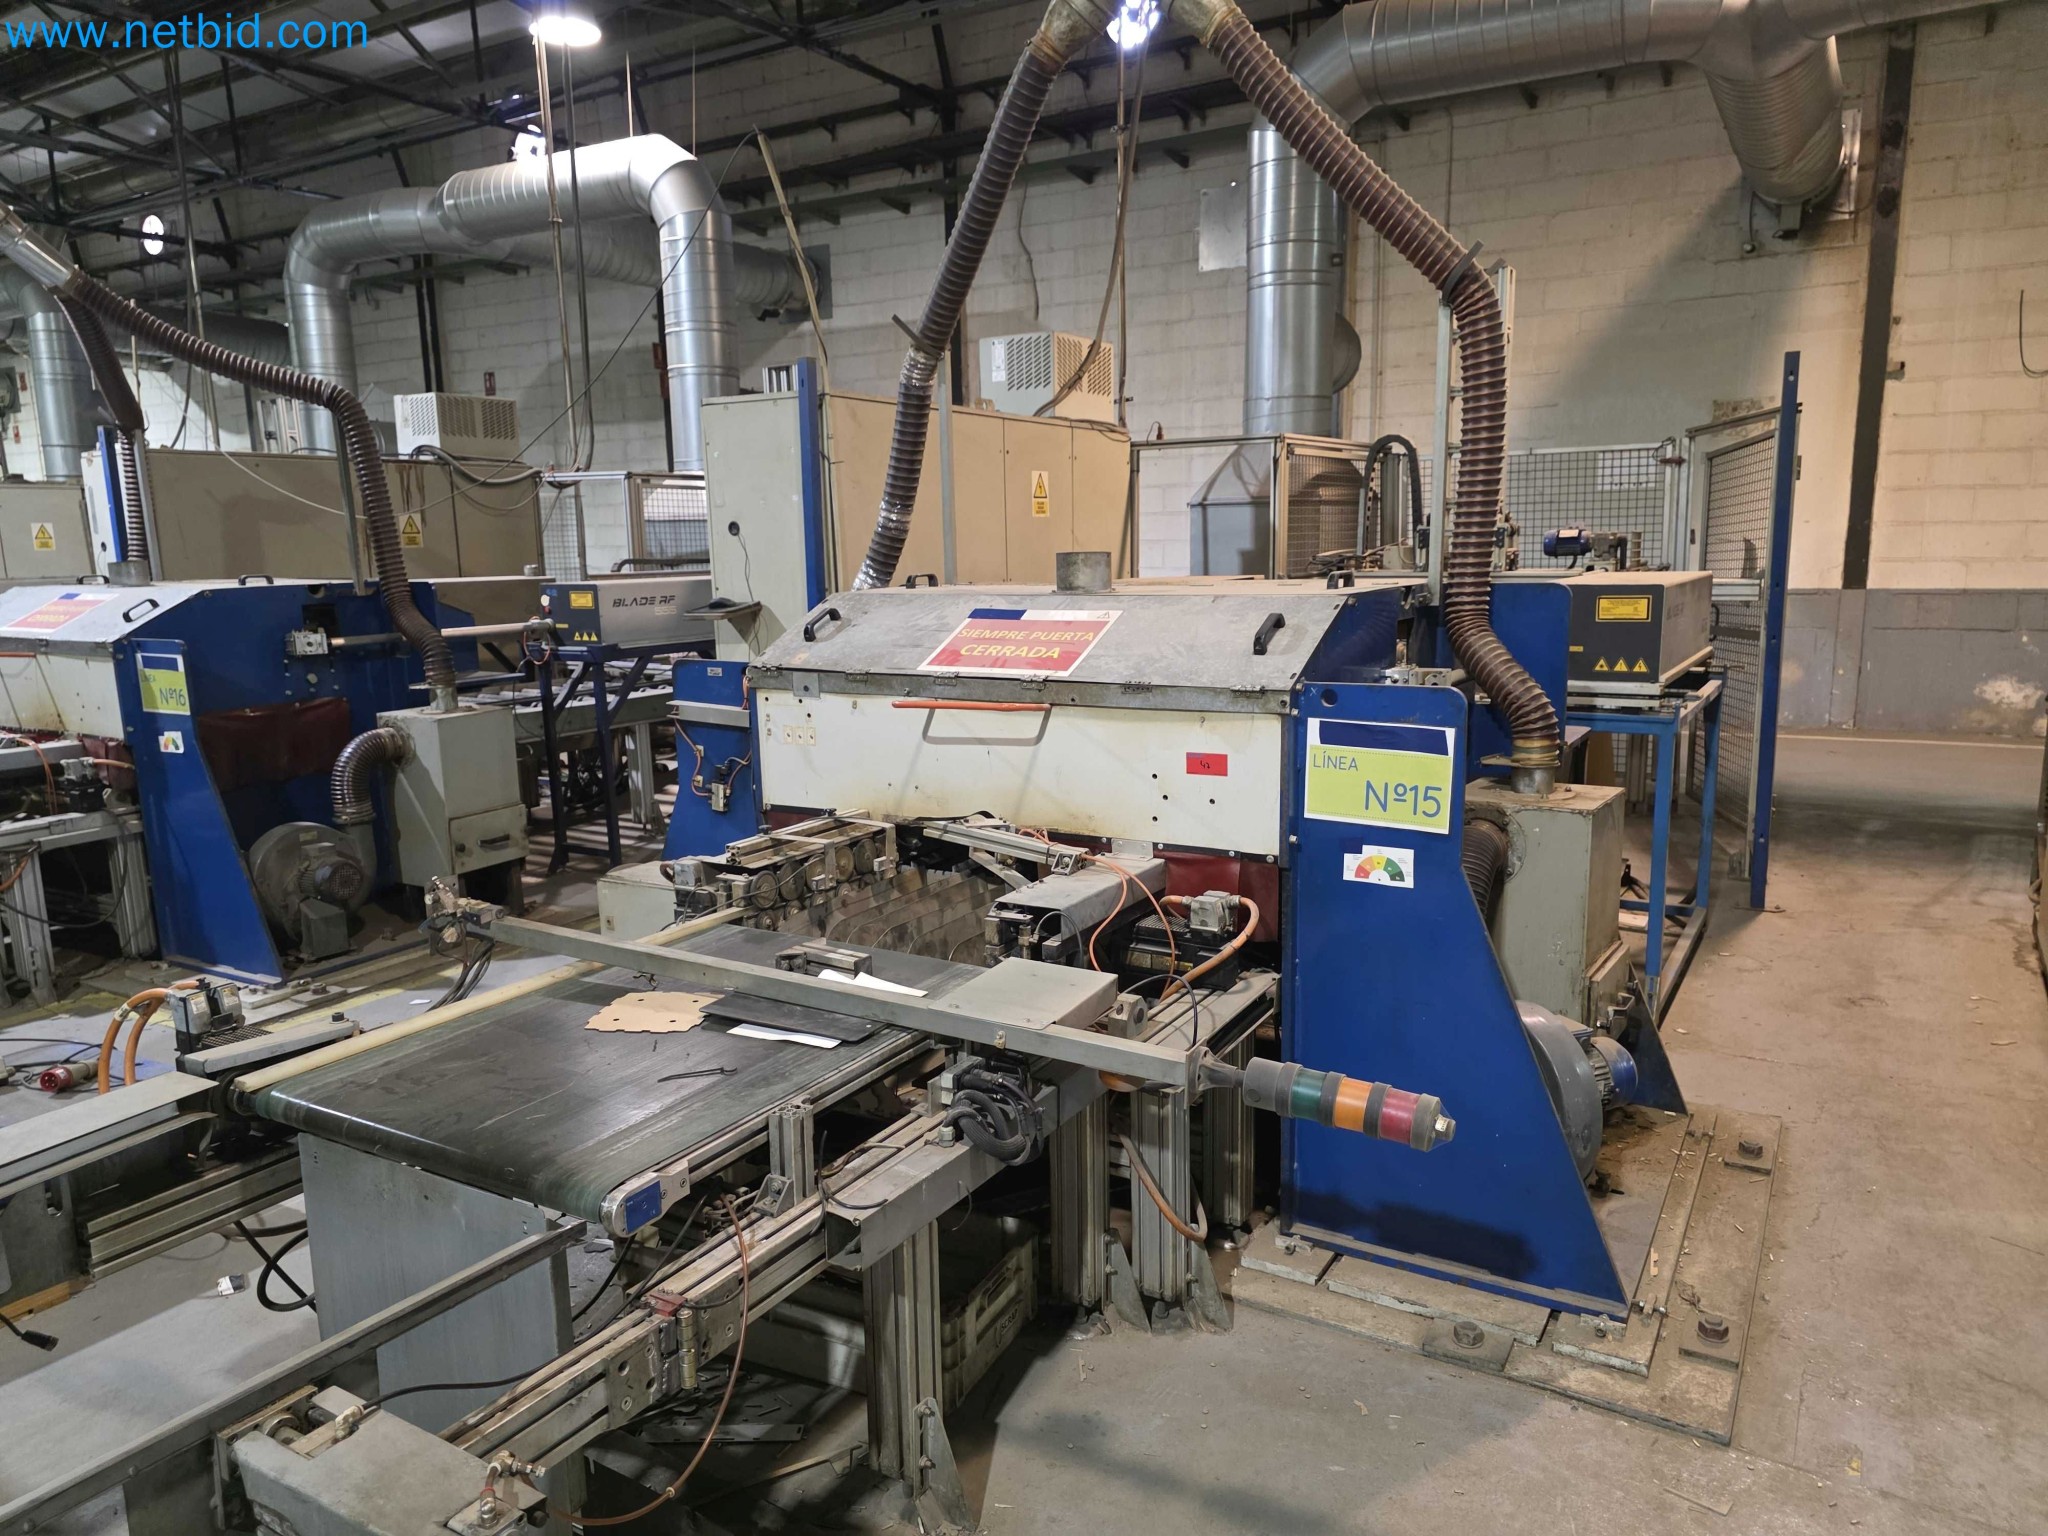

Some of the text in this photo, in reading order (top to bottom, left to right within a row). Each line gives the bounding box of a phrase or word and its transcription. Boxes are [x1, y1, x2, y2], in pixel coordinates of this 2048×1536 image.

[613, 594, 676, 608] BLADE RF
[958, 628, 1095, 641] SIEMPRE PUERTA
[960, 644, 1060, 659] CERRADA
[1313, 751, 1358, 771] LÍNEA
[1365, 780, 1442, 818] Nº15
